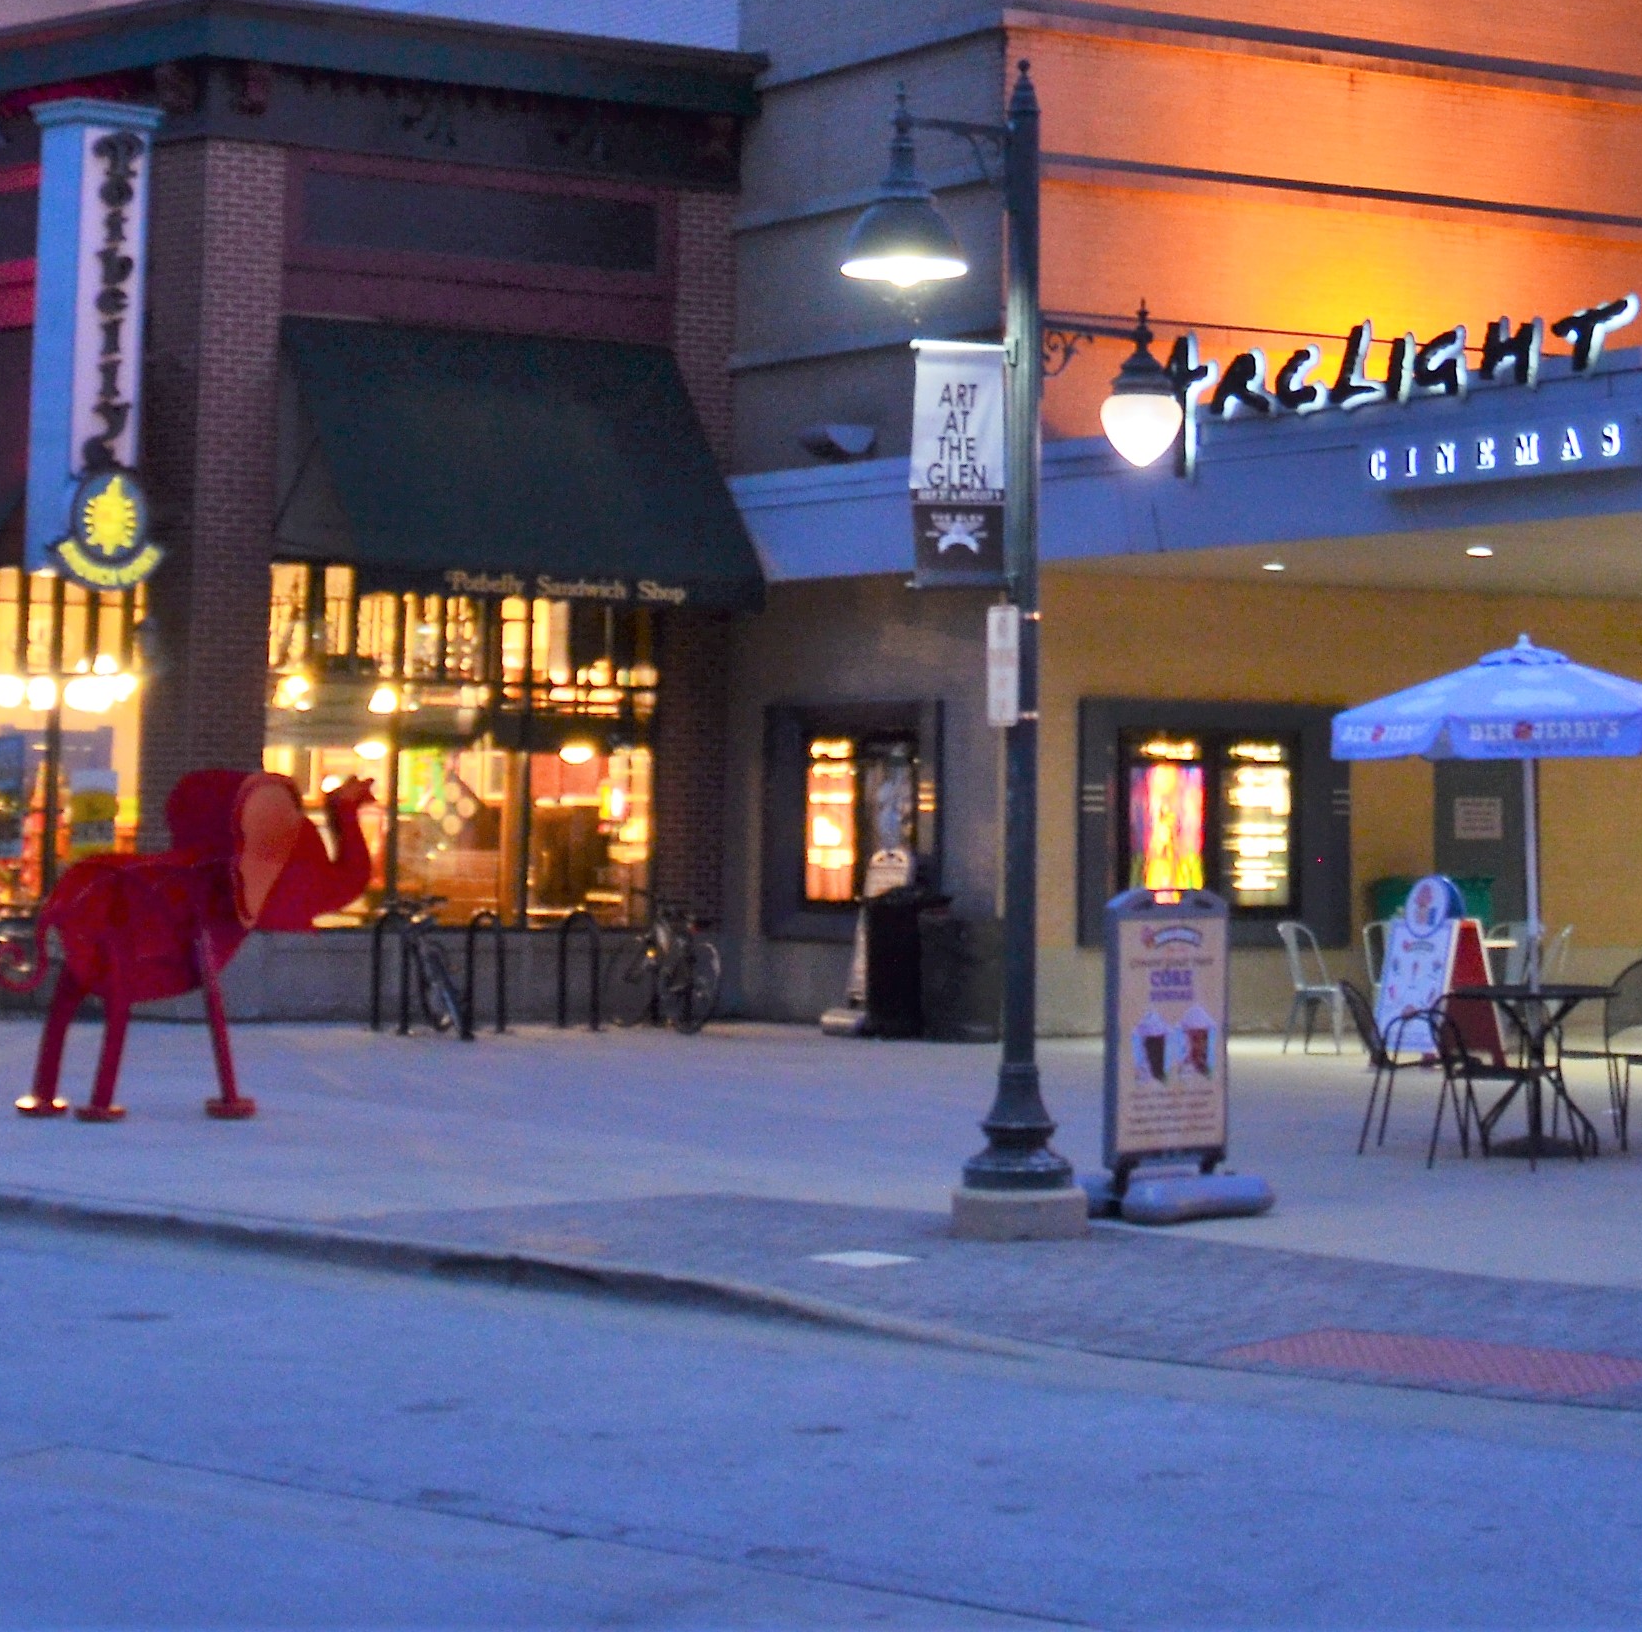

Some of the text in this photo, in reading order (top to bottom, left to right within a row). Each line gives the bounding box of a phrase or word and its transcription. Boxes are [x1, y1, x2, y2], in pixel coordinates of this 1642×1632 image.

[83, 130, 145, 471] Potbelly
[938, 383, 977, 408] ART
[944, 410, 970, 435] AT
[937, 435, 976, 461] THE
[1369, 423, 1621, 481] CINEMAS
[927, 462, 987, 491] GLEN
[637, 579, 687, 605] Shop
